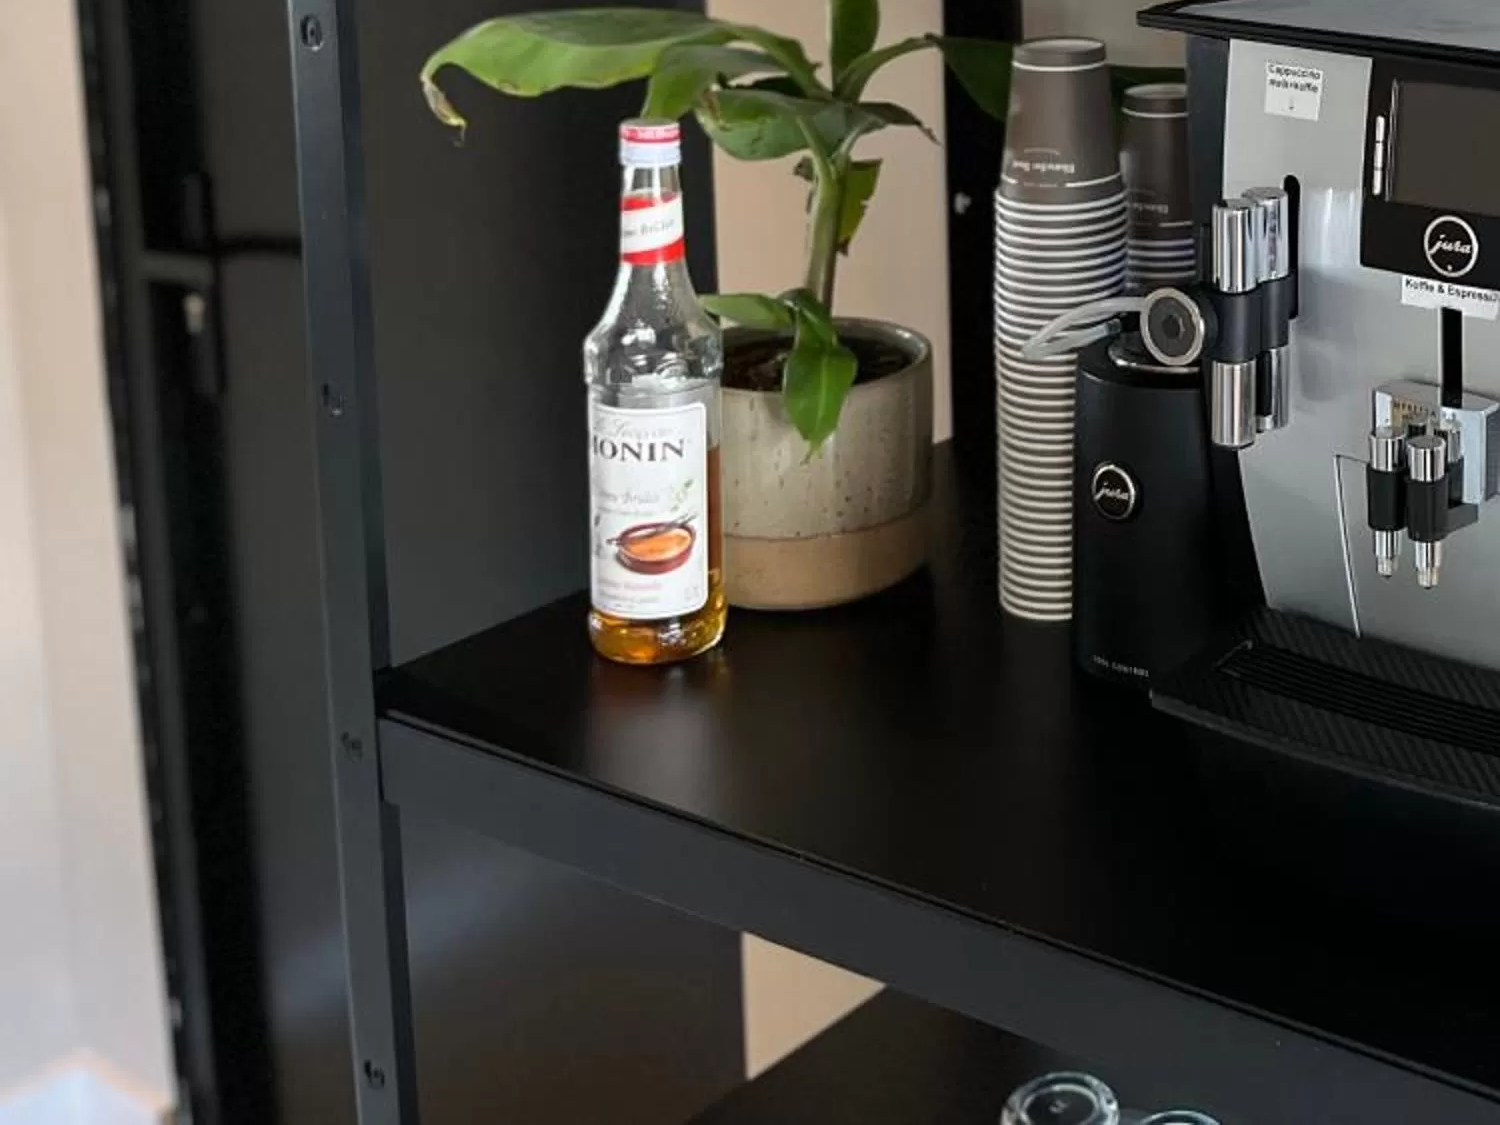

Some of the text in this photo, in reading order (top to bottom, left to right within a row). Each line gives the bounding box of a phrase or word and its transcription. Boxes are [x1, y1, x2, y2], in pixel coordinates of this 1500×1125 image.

[1428, 233, 1472, 256] jura
[1405, 278, 1436, 292] Koffie
[1437, 284, 1446, 295] &
[1093, 480, 1130, 502] jura
